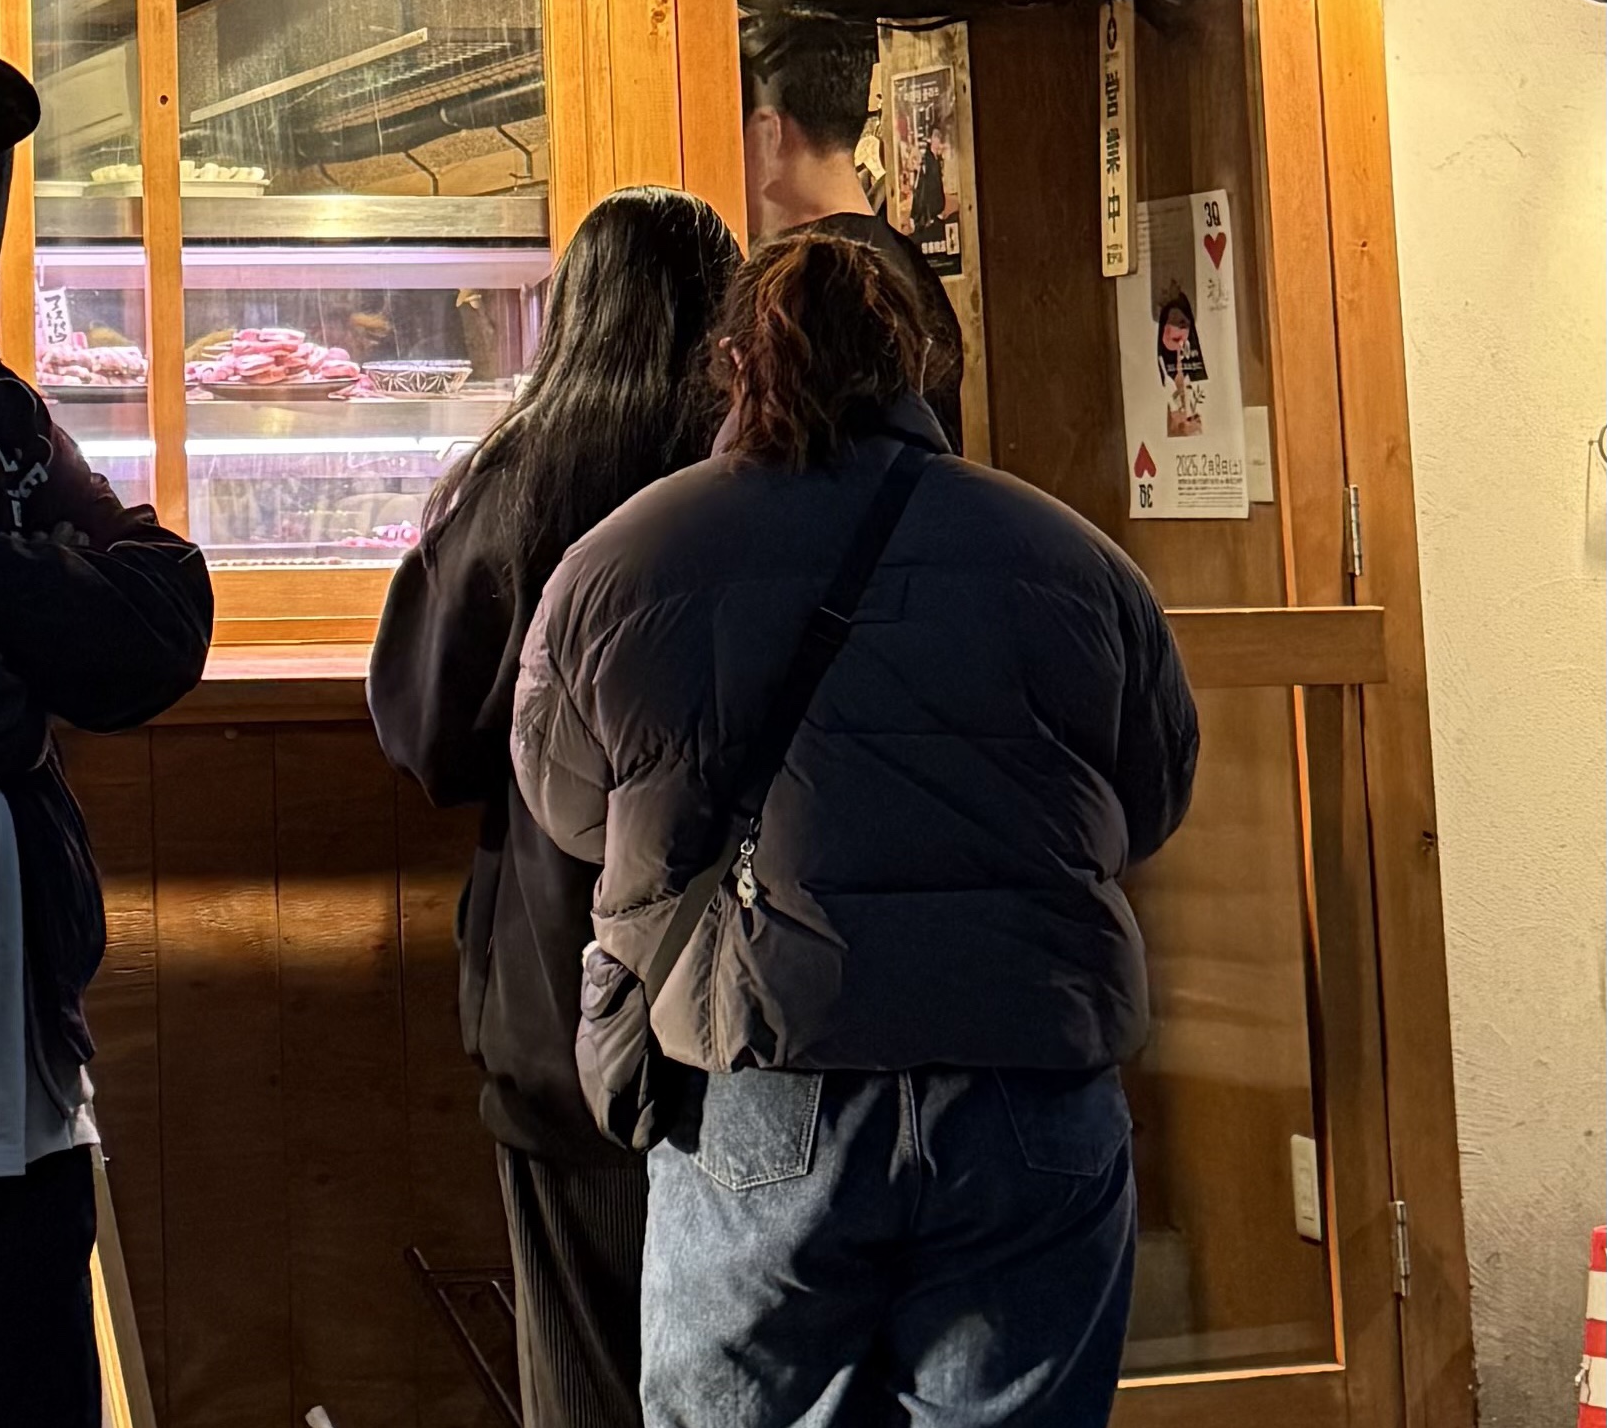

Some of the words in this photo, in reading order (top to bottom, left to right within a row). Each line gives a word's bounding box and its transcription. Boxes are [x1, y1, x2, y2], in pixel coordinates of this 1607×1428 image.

[1105, 71, 1120, 233] 営業中
[1204, 201, 1222, 227] 3Q
